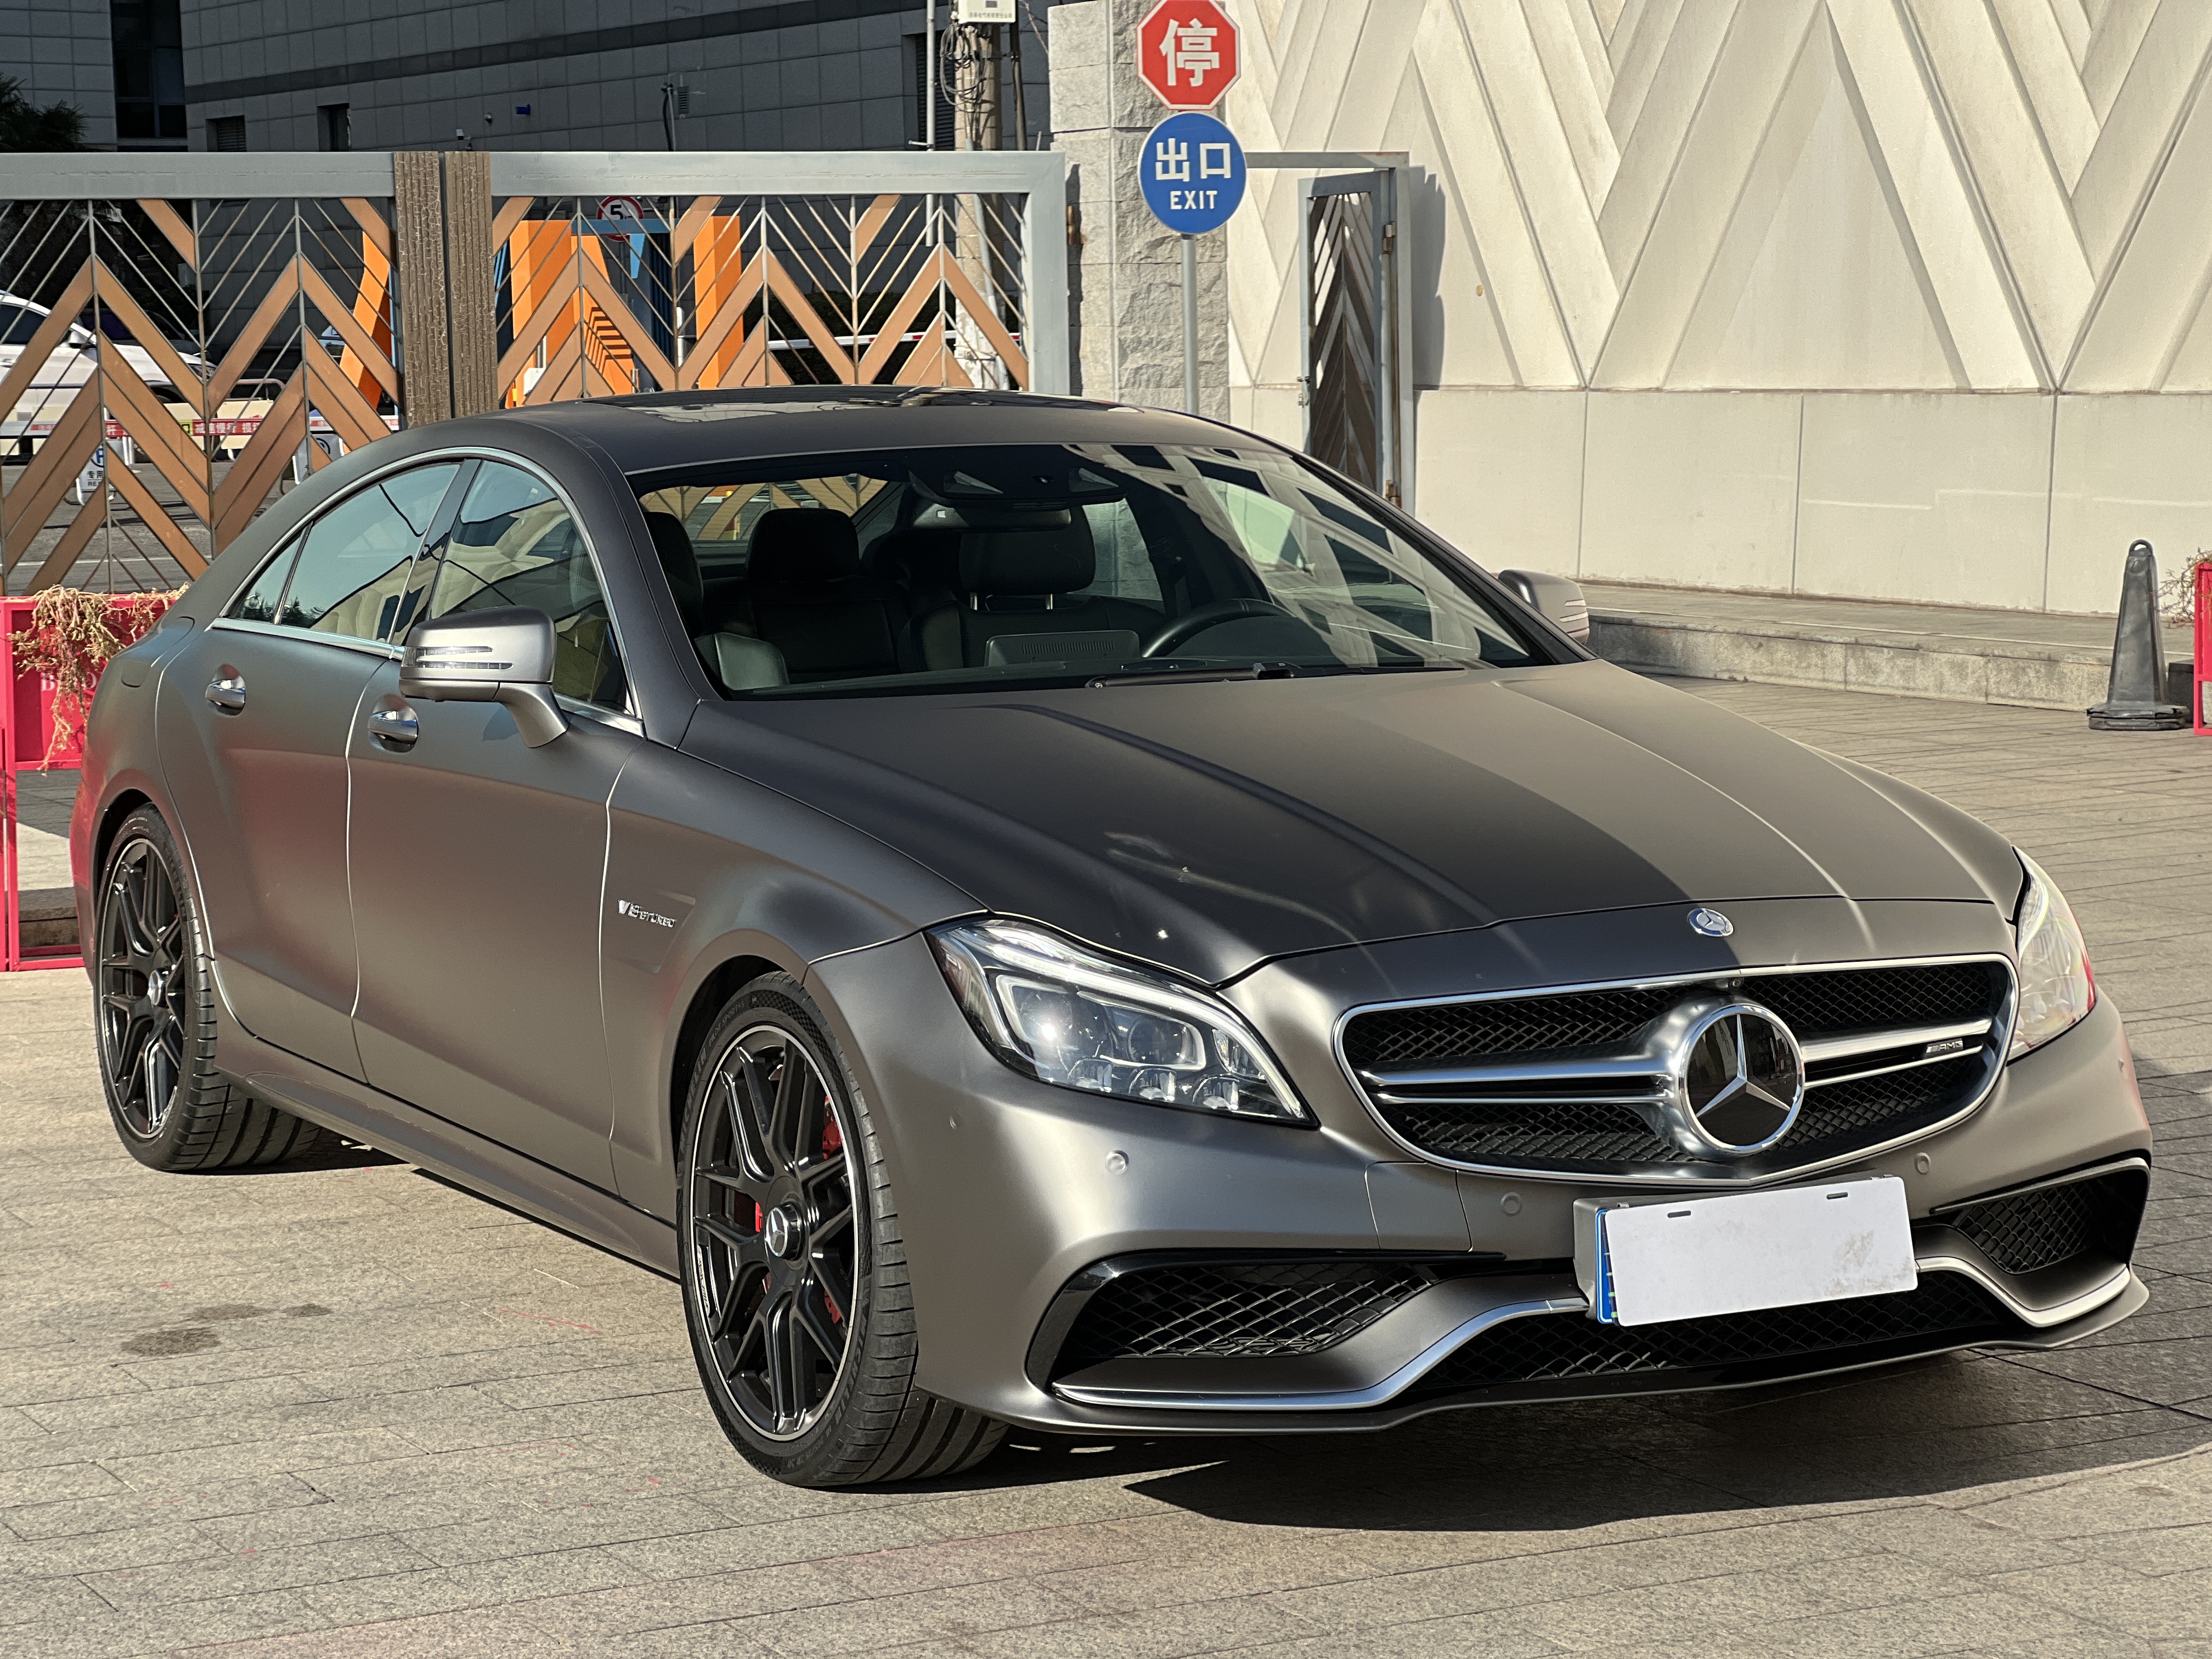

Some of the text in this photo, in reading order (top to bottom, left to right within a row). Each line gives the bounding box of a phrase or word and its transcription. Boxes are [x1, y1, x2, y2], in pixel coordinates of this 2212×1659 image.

[1159, 18, 1220, 87] 停
[1155, 138, 1232, 182] 出口
[1170, 190, 1218, 210] EXIT
[1939, 1040, 1963, 1051] AMG
